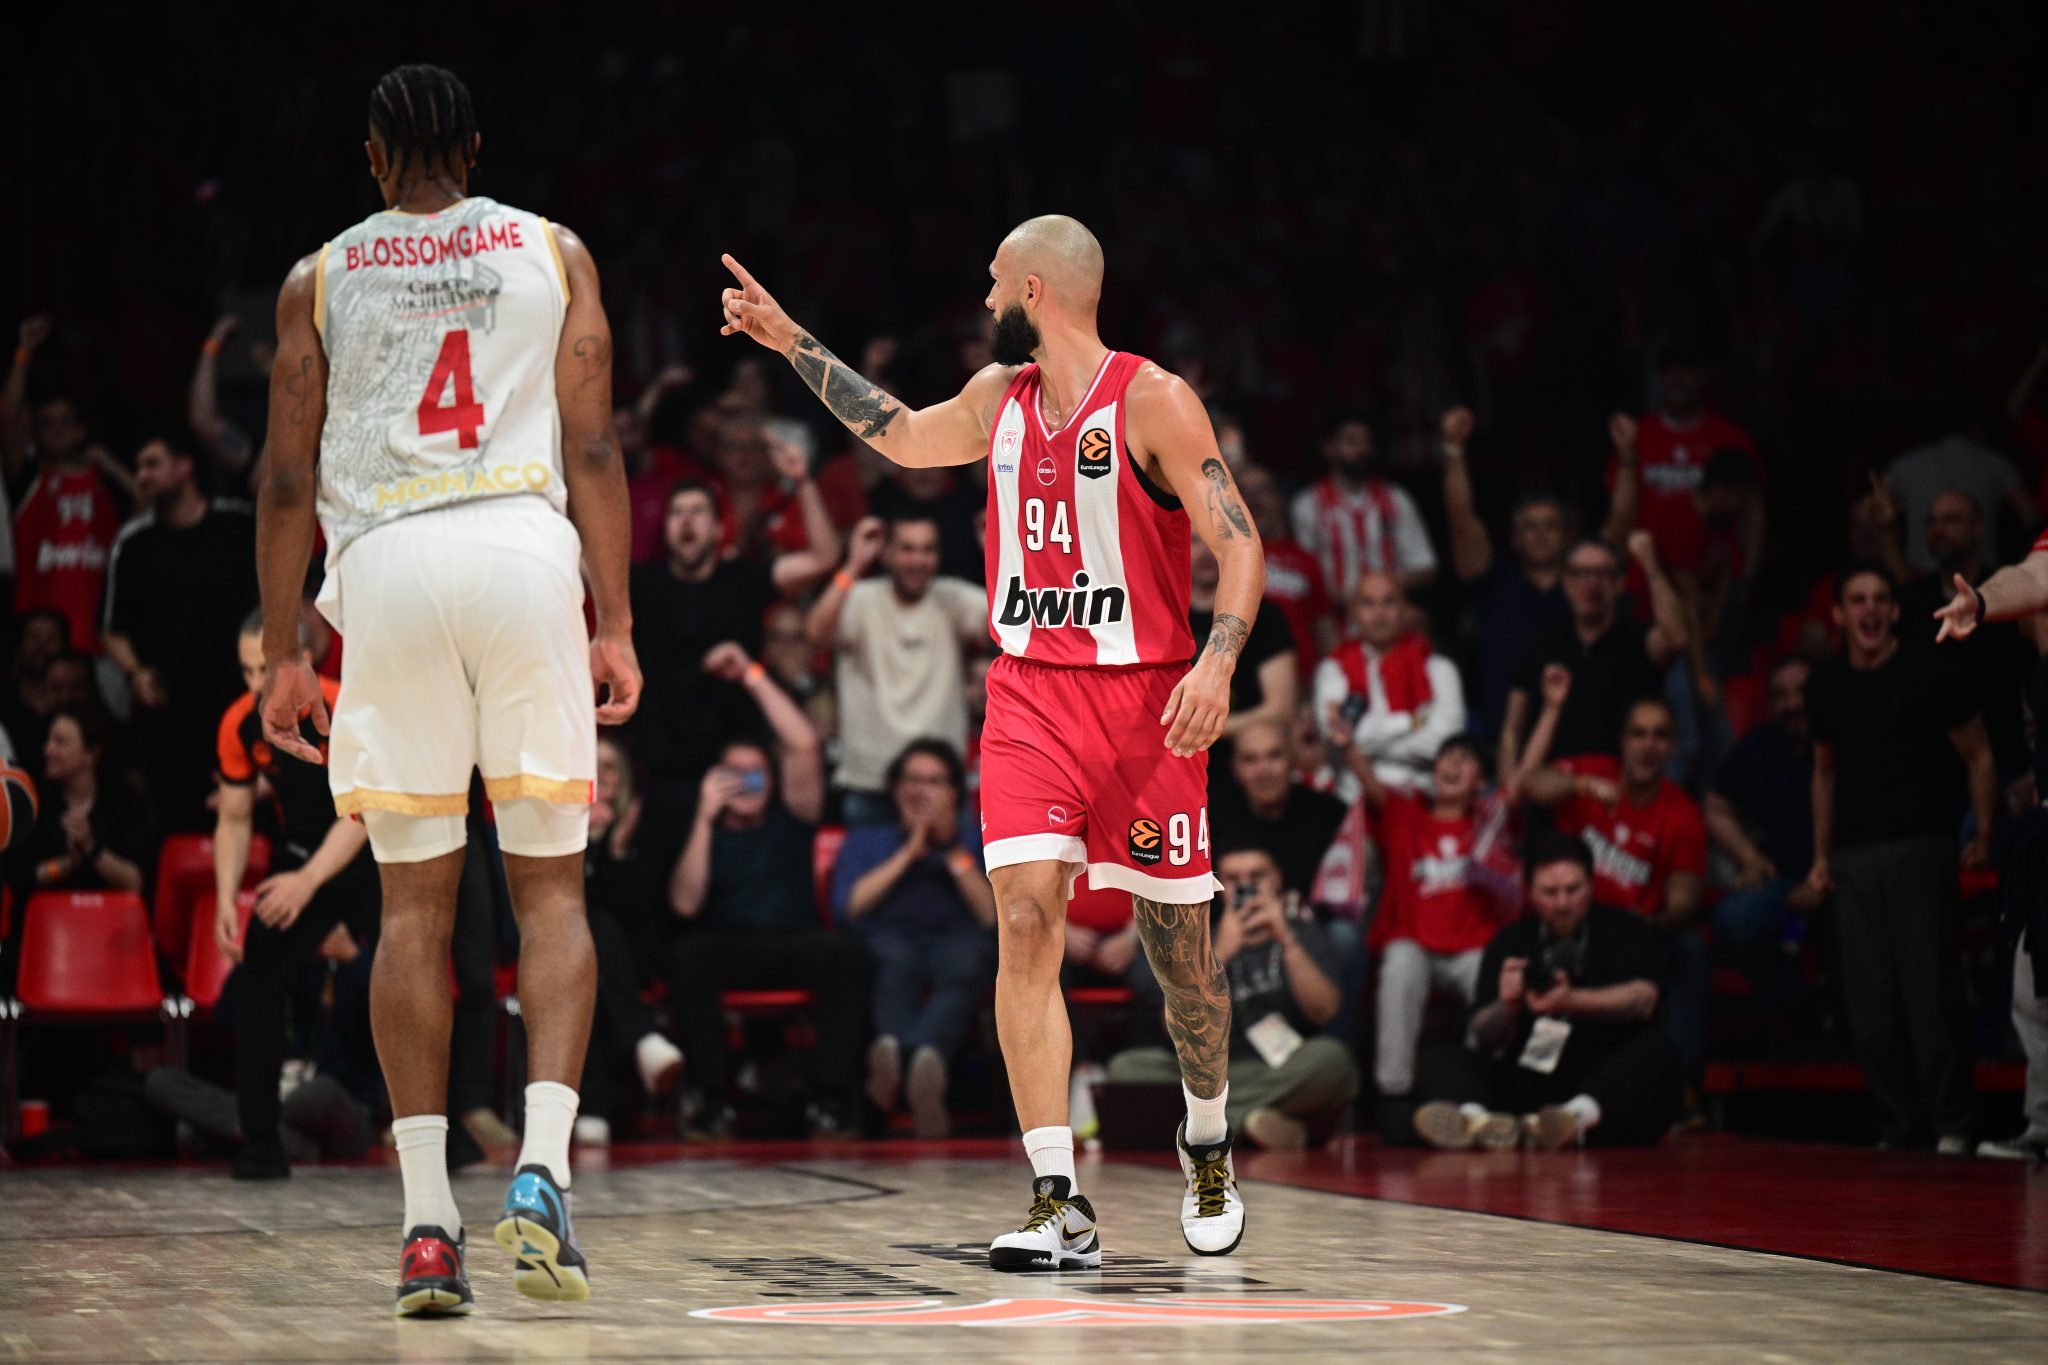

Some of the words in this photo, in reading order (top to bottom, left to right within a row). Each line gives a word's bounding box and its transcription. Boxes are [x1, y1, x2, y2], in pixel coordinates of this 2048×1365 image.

[345, 222, 524, 272] BLOSSOMGAME
[417, 329, 485, 450] 4
[375, 463, 550, 509] MONACO
[1025, 497, 1073, 555] 94
[998, 570, 1126, 629] bwin
[1131, 850, 1159, 859] EuroLeague
[1168, 805, 1210, 866] 94
